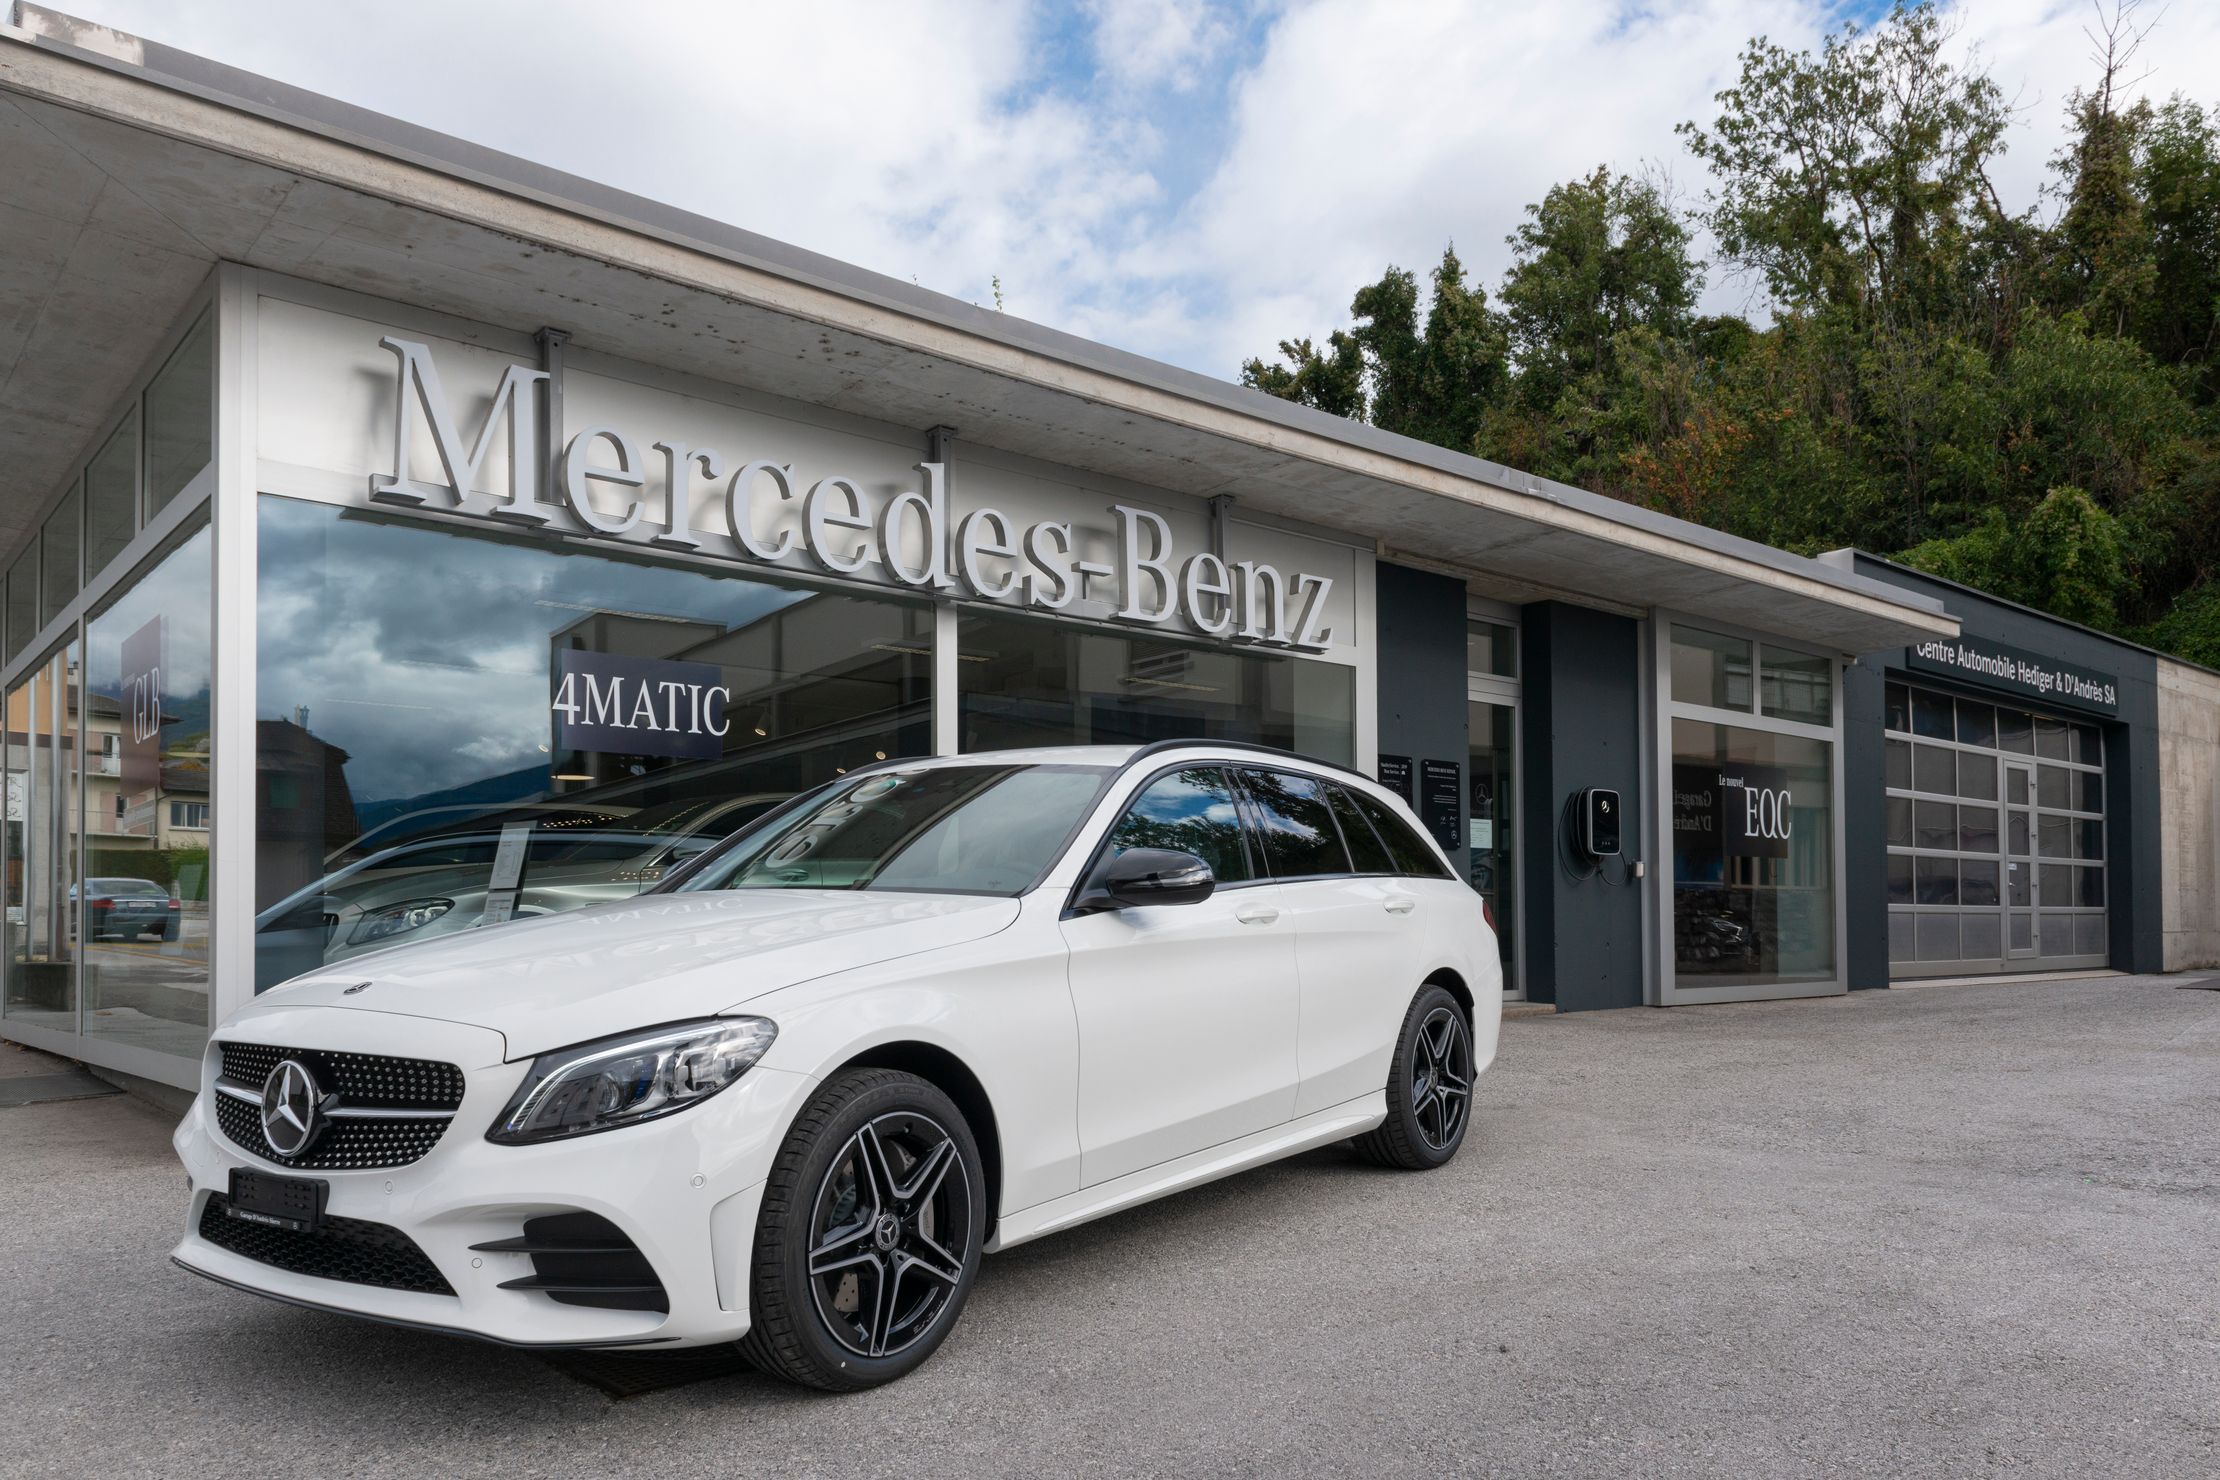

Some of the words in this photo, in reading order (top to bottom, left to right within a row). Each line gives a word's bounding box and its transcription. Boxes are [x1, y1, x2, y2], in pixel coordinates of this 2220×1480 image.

[370, 335, 1334, 652] Mercedes-Benz
[133, 667, 160, 745] GLB
[552, 673, 731, 737] 4MATIC
[1957, 644, 2015, 680] Automobile
[2018, 661, 2054, 693] Hediger
[2056, 673, 2063, 692] &
[2065, 673, 2103, 702] D'Andrès
[2104, 685, 2116, 706] SA
[1744, 787, 1792, 840] EQC
